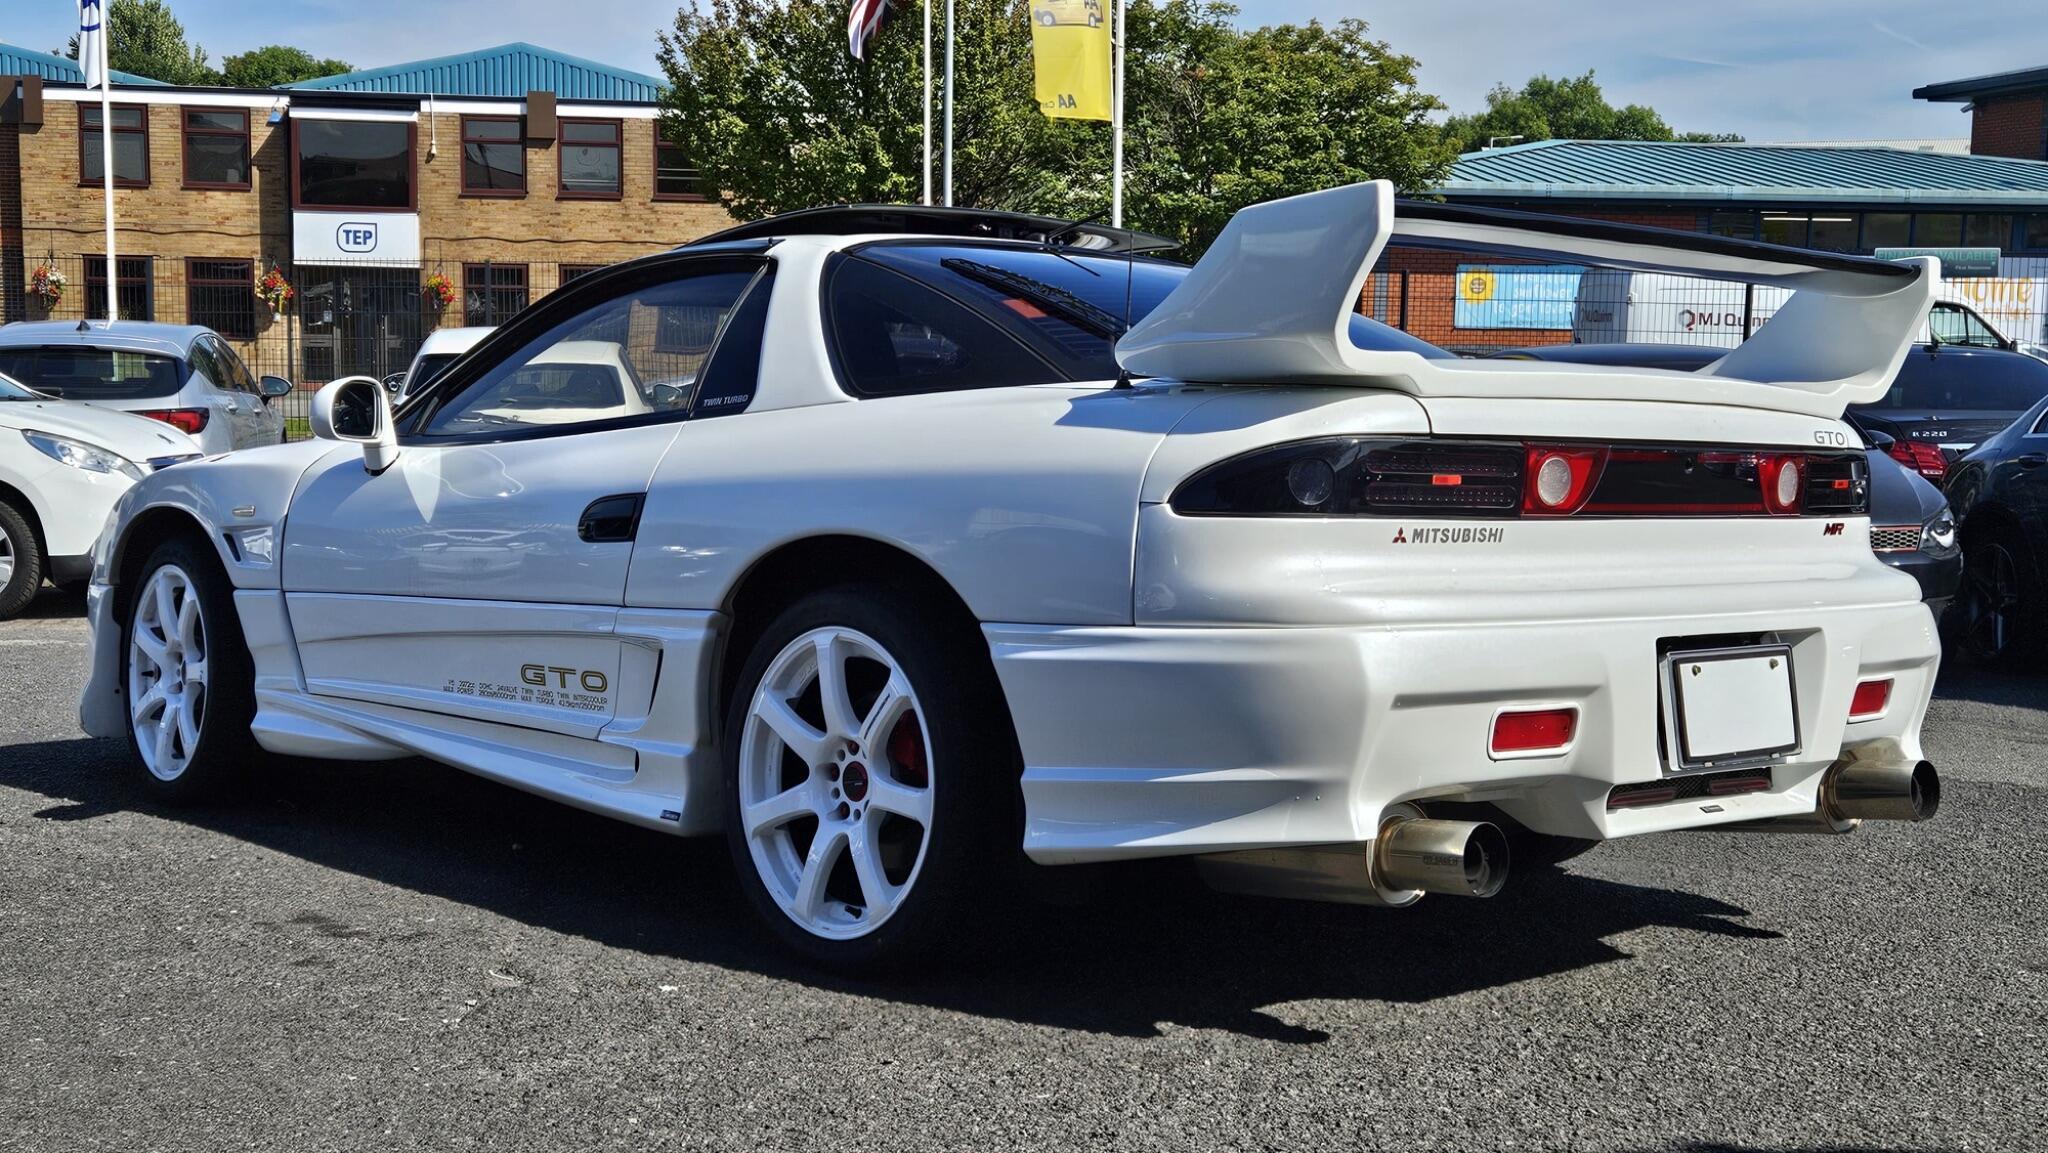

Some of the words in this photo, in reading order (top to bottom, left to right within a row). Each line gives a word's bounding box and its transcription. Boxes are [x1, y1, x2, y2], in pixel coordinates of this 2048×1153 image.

[342, 229, 373, 246] TEP
[1698, 312, 1721, 327] MJ
[1724, 312, 1771, 328] Qunn
[703, 397, 722, 407] TWIN
[723, 394, 749, 405] TURBO
[1814, 430, 1845, 446] GTO
[1411, 527, 1505, 544] MITSUBISHI
[1823, 522, 1845, 536] MR
[520, 663, 608, 693] GTO
